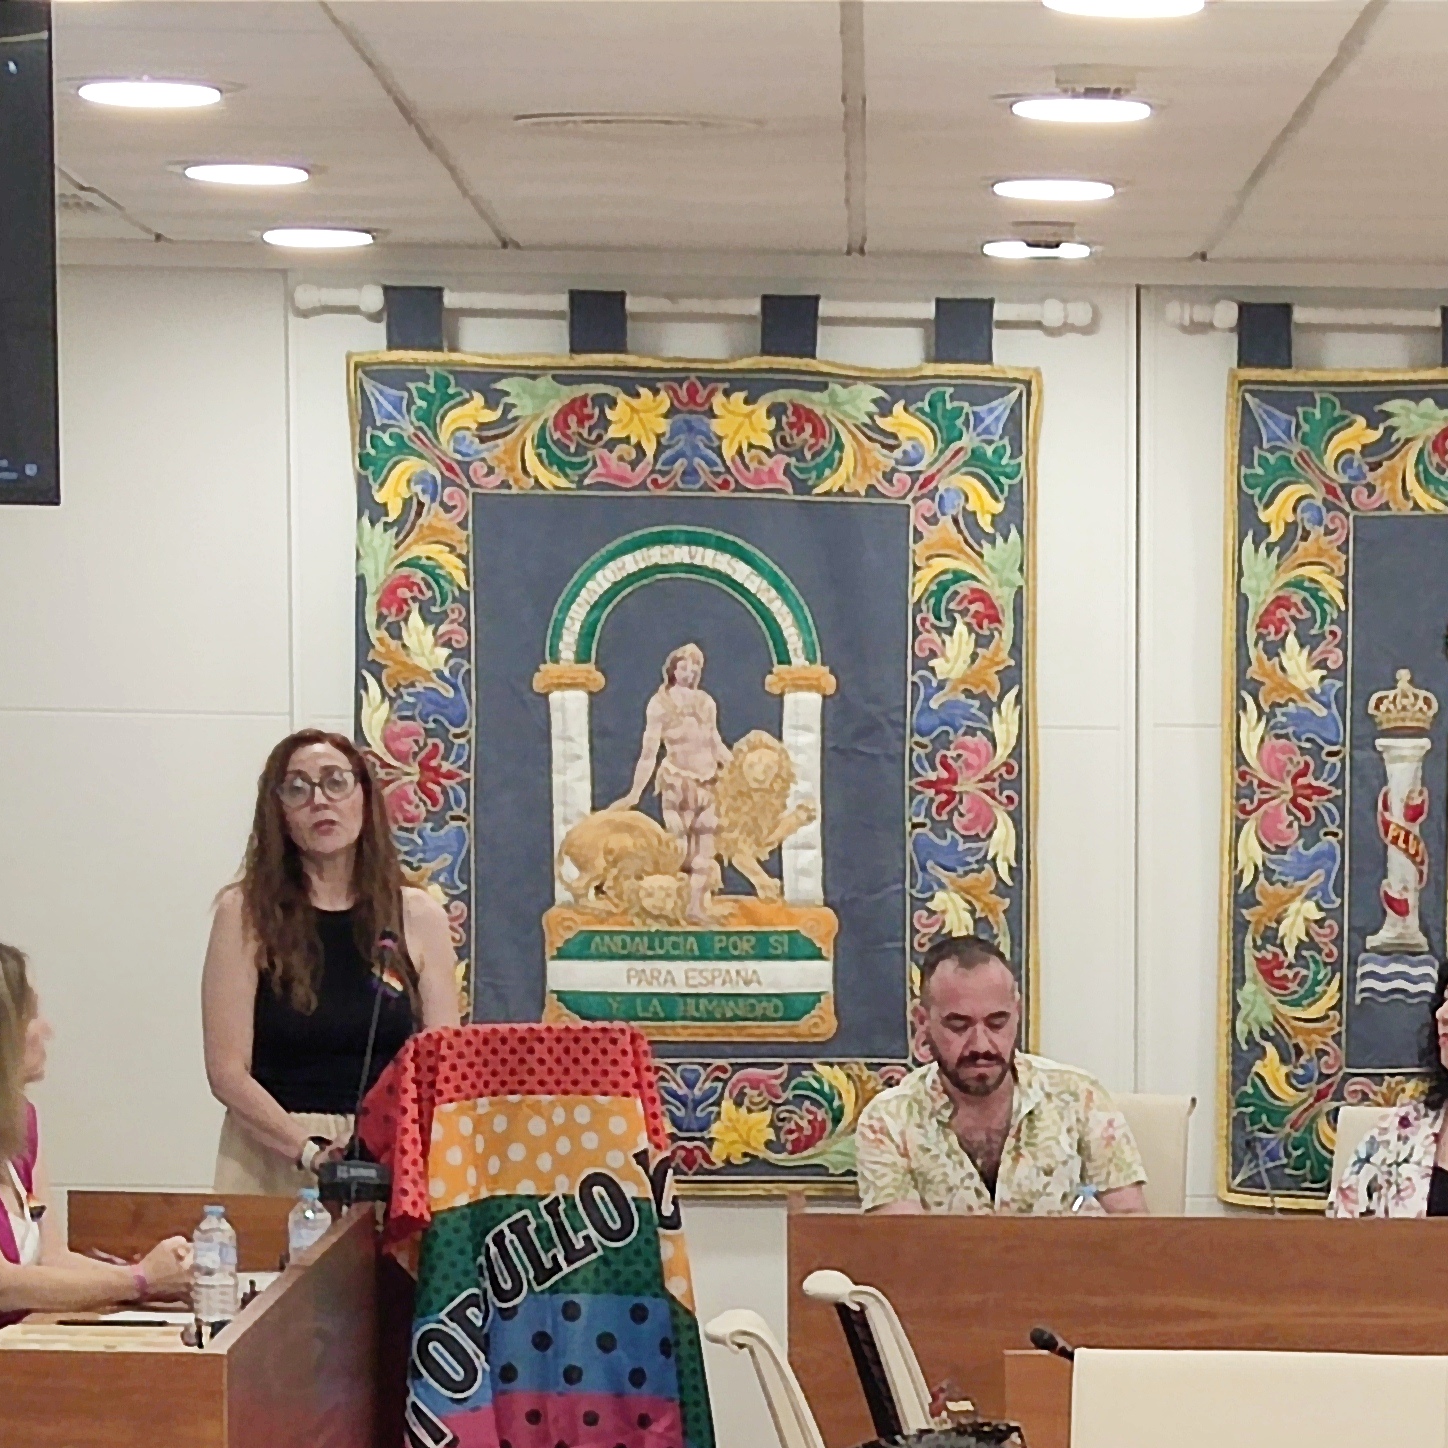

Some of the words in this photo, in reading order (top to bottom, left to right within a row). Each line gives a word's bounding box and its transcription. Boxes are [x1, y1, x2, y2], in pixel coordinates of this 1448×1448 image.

[713, 935, 757, 956] POR
[626, 967, 677, 988] PARA
[636, 997, 665, 1018] LA
